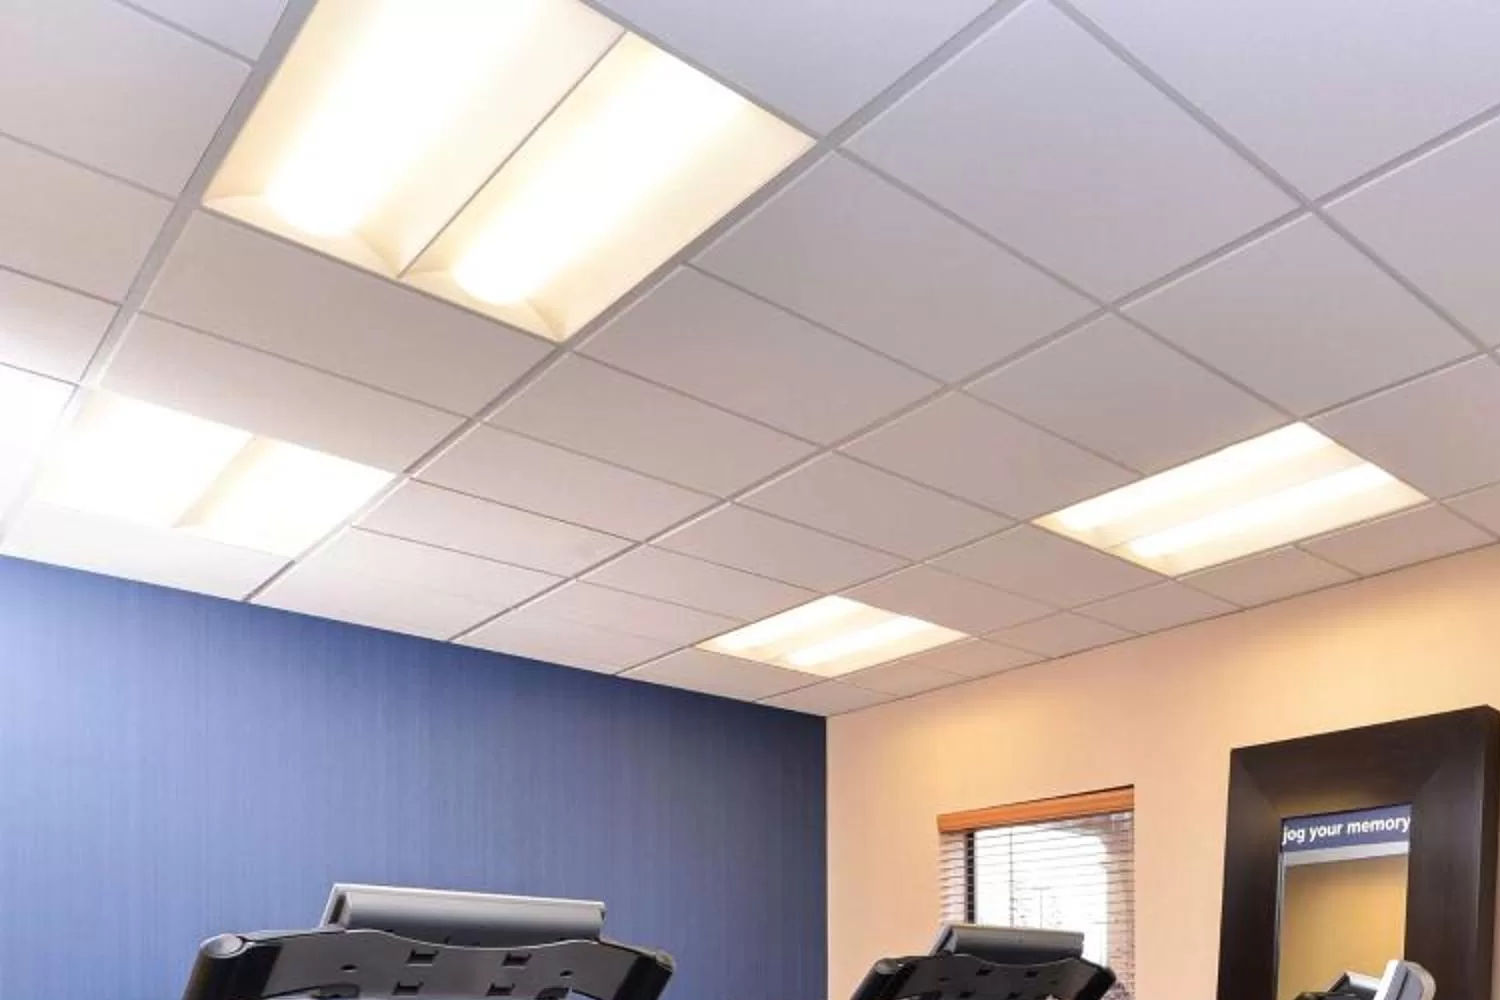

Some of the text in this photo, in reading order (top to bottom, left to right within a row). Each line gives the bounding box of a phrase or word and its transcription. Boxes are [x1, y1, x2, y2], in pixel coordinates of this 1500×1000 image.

[1282, 816, 1411, 846] jog your memory
